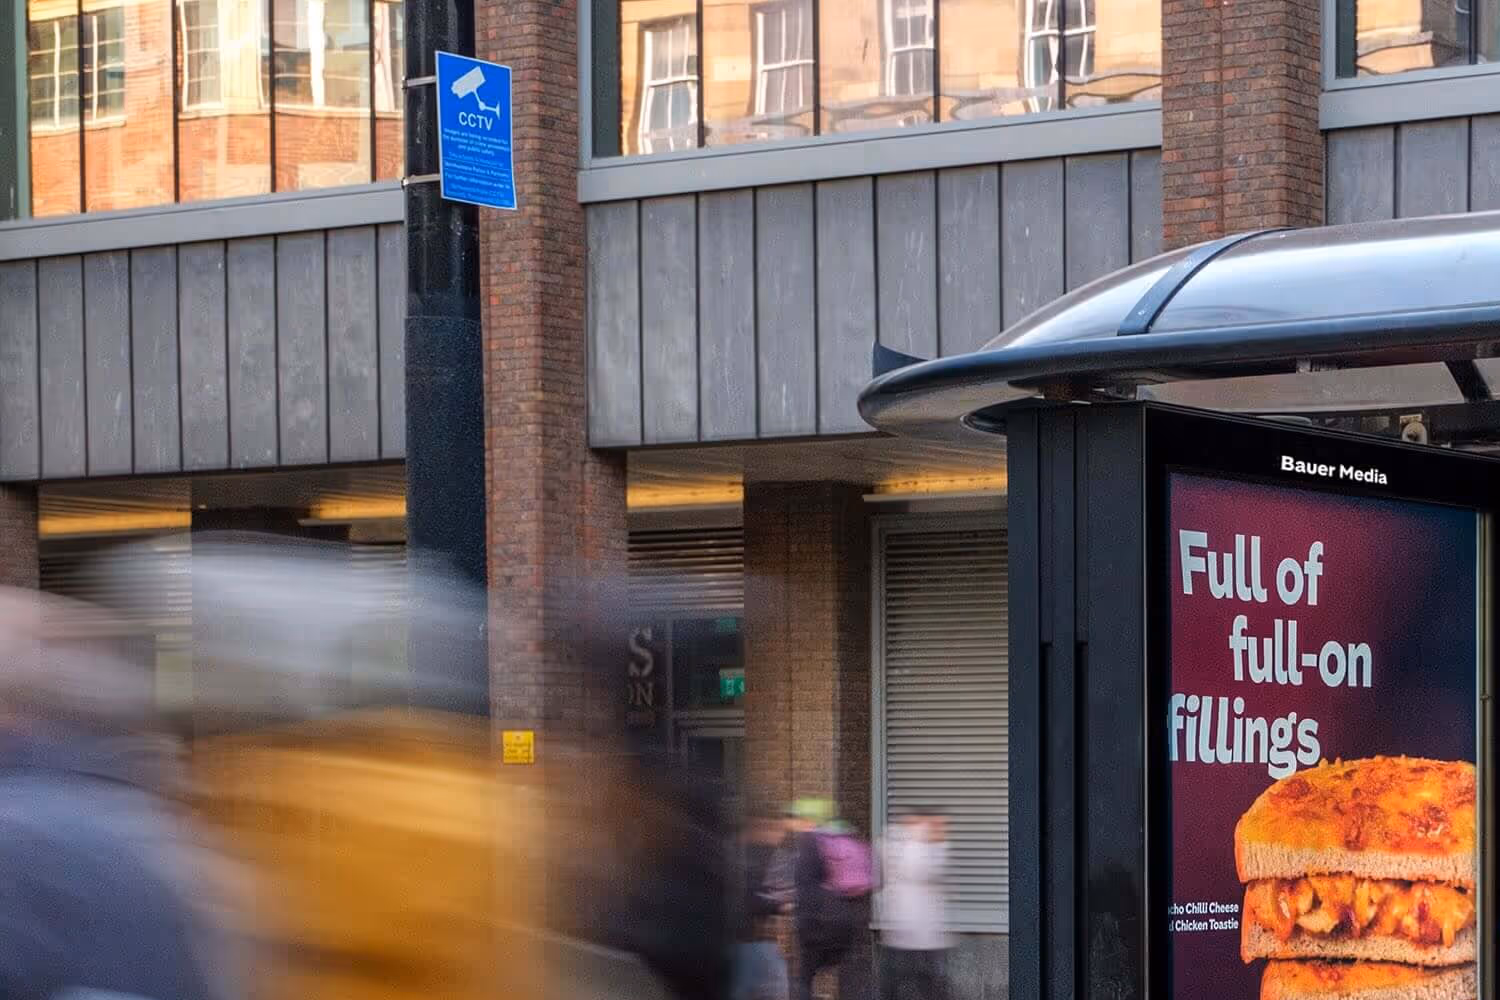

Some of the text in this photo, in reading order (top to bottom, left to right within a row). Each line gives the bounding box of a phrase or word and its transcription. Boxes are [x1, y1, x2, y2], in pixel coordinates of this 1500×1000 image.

[459, 111, 493, 131] CCTV
[1281, 455, 1388, 485] Bauer Media
[1179, 529, 1324, 606] Full of
[1229, 614, 1373, 688] full-on
[1167, 693, 1321, 781] fillings
[1186, 902, 1208, 914] Chilli
[1209, 901, 1239, 914] Cheese
[1175, 920, 1208, 932] Chicken
[1209, 917, 1239, 930] Toastie
